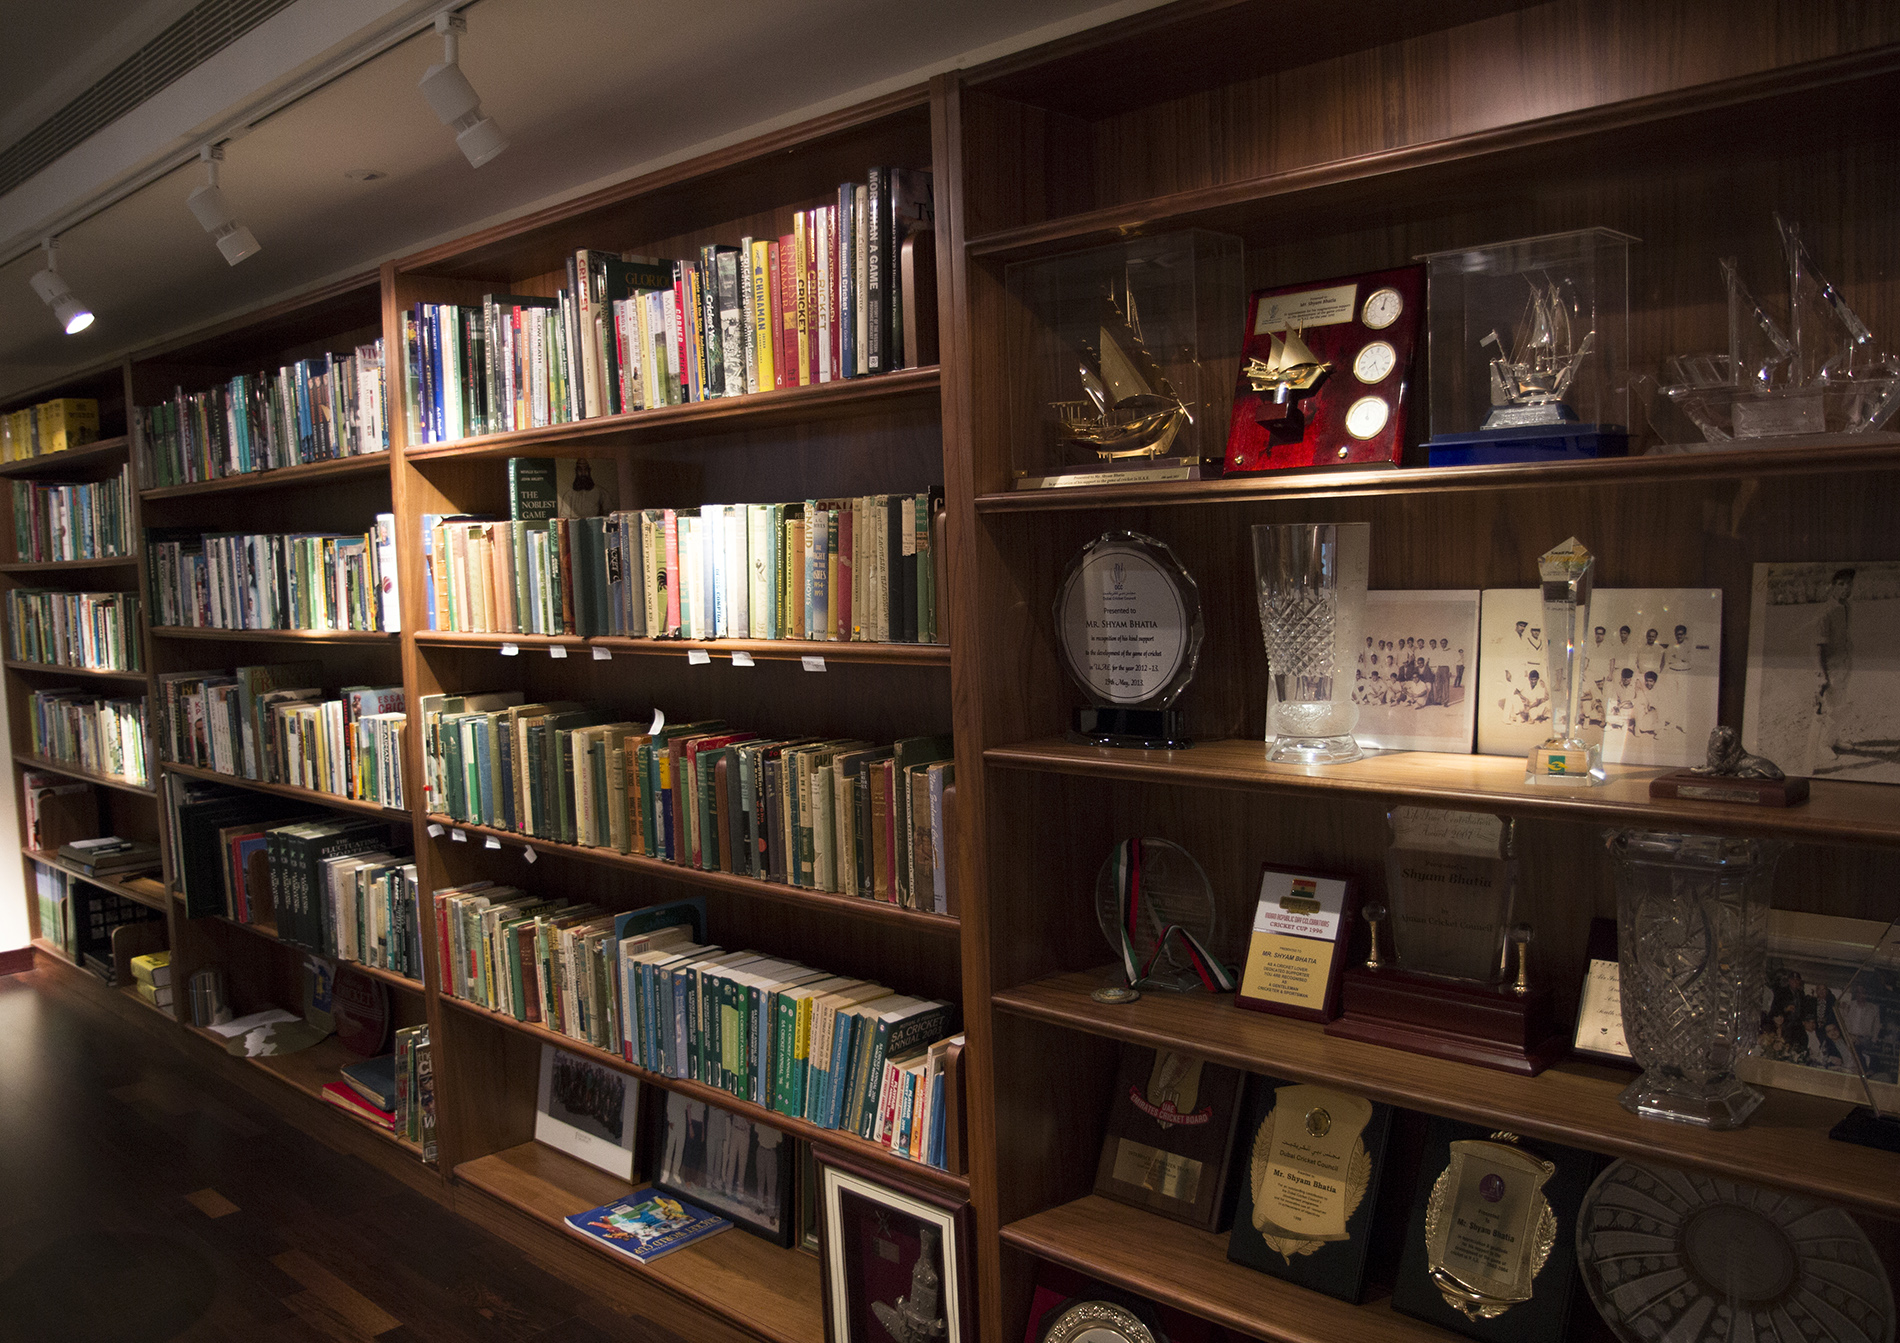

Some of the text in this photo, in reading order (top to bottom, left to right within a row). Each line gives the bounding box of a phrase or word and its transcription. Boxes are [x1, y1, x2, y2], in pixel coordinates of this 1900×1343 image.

[779, 245, 788, 308] SUMMER
[786, 244, 797, 306] ENDLESS
[870, 255, 878, 290] GAME
[579, 260, 588, 312] CRICKET
[745, 296, 751, 305] in
[755, 277, 765, 330] CHINAMAN
[807, 270, 818, 332] CRICKET
[818, 270, 826, 331] CRICKET
[706, 294, 714, 328] Cricket
[521, 500, 556, 509] NOBLEST
[522, 511, 547, 519] GAME
[1401, 868, 1491, 888] Shyam Bhatia
[1270, 921, 1294, 930] CRICKET
[1277, 913, 1294, 921] REPUBLIC
[1428, 918, 1457, 927] Cricket
[1460, 922, 1492, 932] Council
[1274, 952, 1294, 961] SHYAM
[1295, 956, 1317, 964] BHATIA
[891, 1016, 945, 1043] SA CRICKET
[878, 1043, 884, 1051] SA
[888, 1035, 920, 1053] ANNUAL
[1130, 1093, 1208, 1124] EMIRATES CRICKET BOARD
[1162, 1103, 1175, 1113] UAE
[1280, 1150, 1338, 1171] Dubai Cricket Council
[1273, 1169, 1337, 1193] Mr. Shyam Bhatia
[685, 1216, 722, 1234] CRICKET
[1469, 1222, 1514, 1243] Shyam Bhatia
[652, 1231, 687, 1246] WORLD
